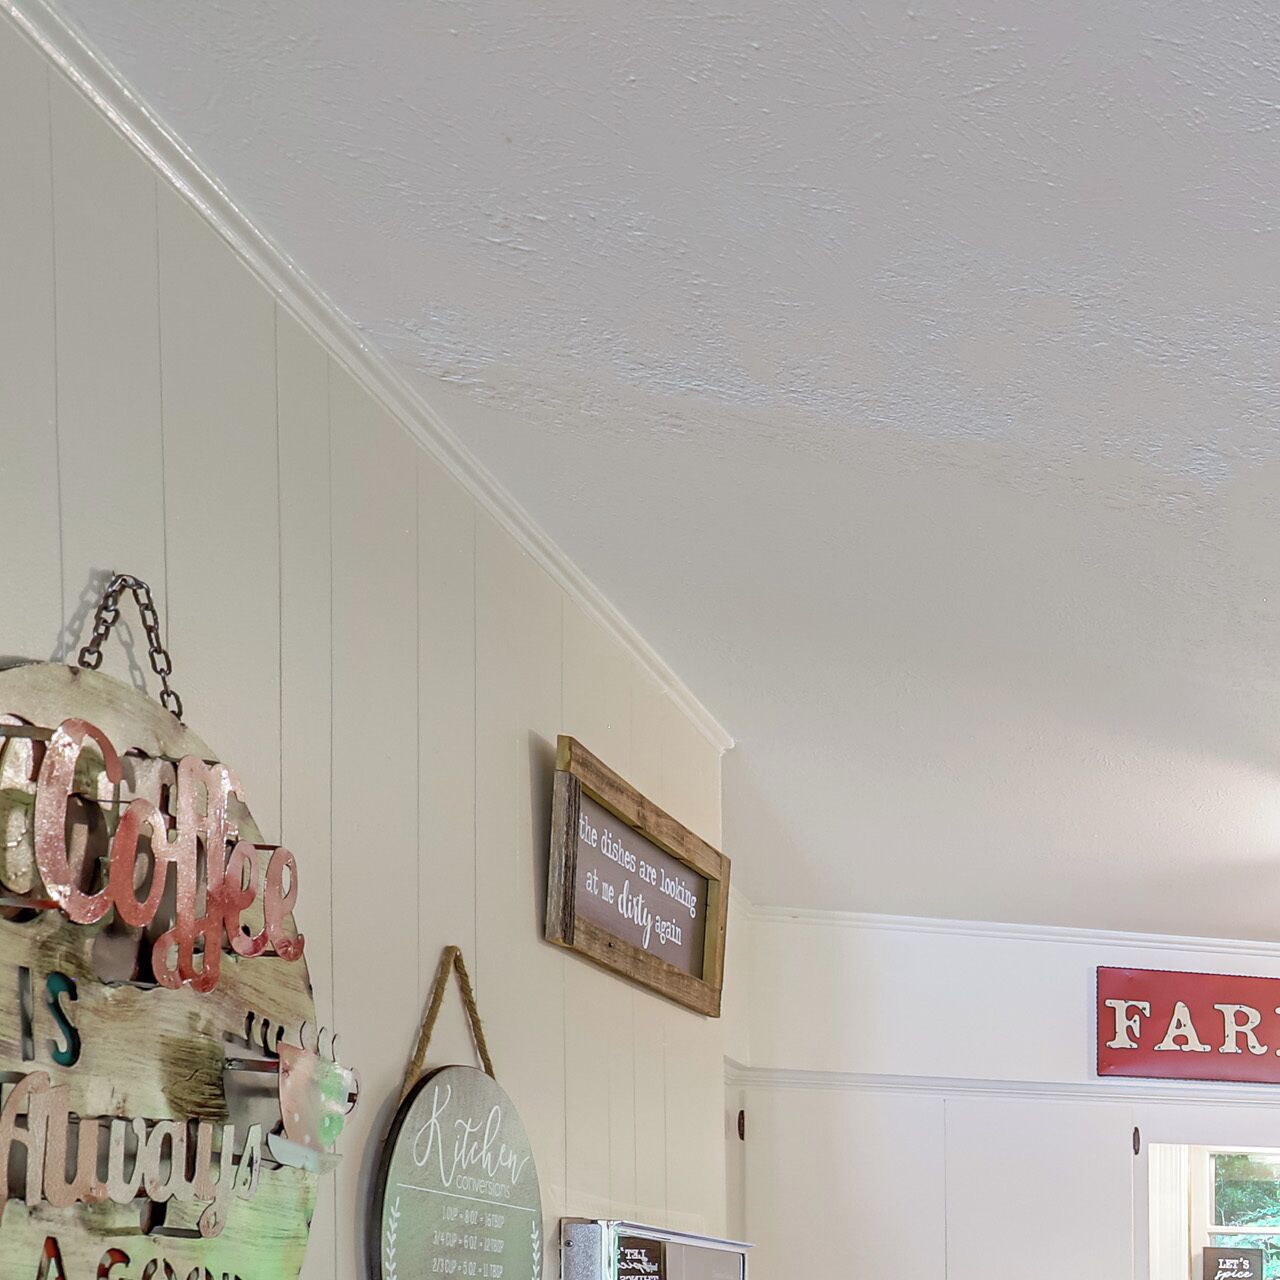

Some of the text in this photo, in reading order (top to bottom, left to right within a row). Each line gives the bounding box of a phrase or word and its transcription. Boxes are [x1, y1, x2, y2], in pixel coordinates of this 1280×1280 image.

[35, 718, 304, 993] Coffee
[579, 813, 697, 918] the dishes are looking
[586, 869, 681, 949] at me dirty again
[18, 966, 80, 1067] IS
[0, 1071, 262, 1240] Always
[413, 1084, 530, 1187] Kitchen
[455, 1174, 511, 1199] conversions
[1218, 1257, 1250, 1270] LET'S
